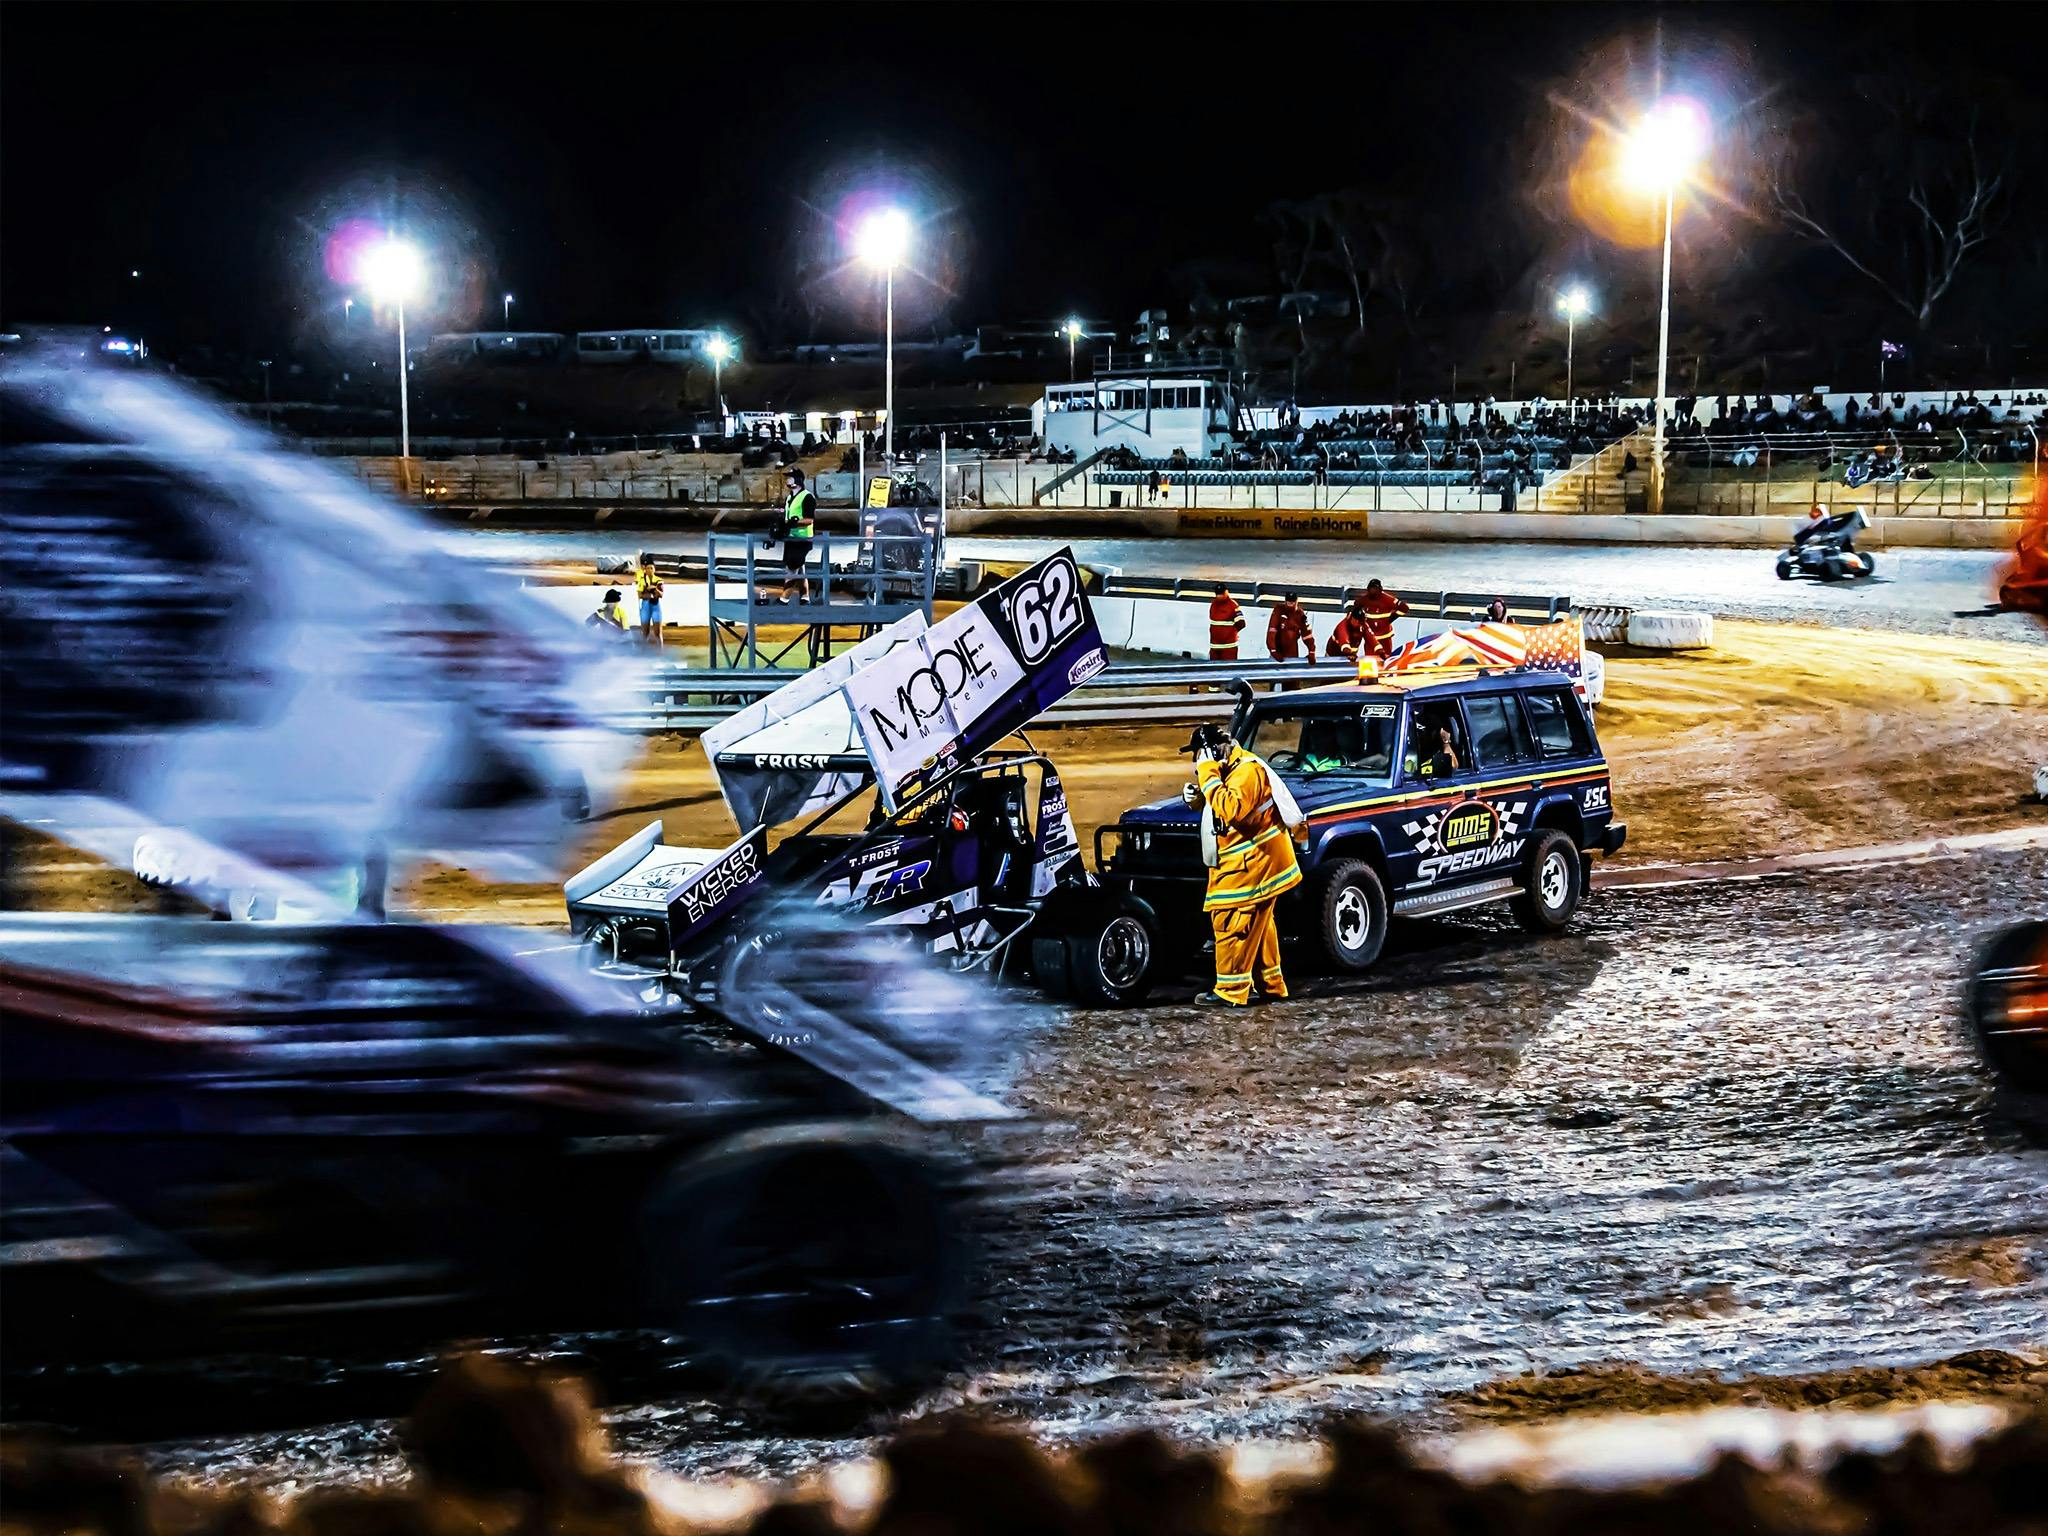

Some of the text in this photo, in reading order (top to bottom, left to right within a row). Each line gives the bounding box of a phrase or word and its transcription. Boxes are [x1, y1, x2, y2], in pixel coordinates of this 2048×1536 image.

[1274, 516, 1362, 531] Raine&Horne
[1013, 559, 1082, 662] 62
[754, 754, 831, 770] FROST
[1042, 800, 1067, 815] FROST
[849, 846, 900, 867] T.FROST
[1406, 839, 1526, 889] SPEEDWAY
[680, 843, 754, 907] WICKED
[688, 854, 758, 924] ENERGY
